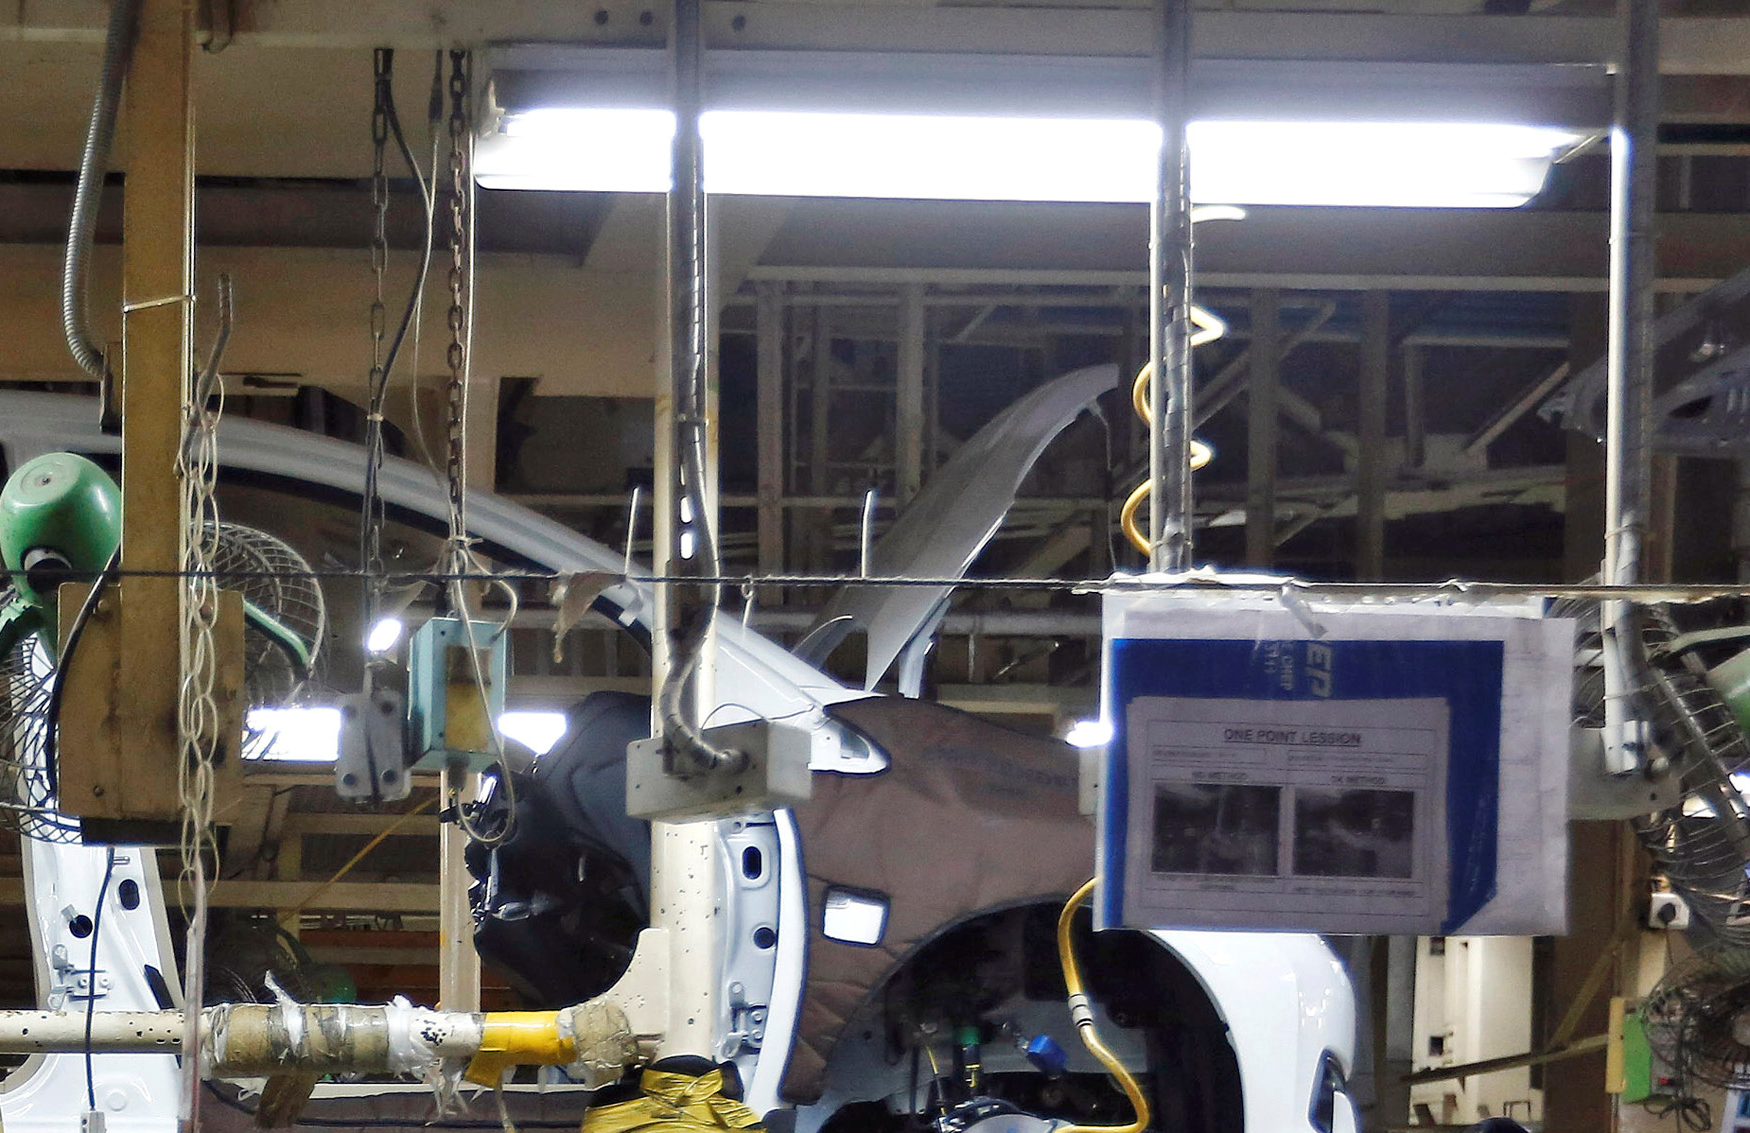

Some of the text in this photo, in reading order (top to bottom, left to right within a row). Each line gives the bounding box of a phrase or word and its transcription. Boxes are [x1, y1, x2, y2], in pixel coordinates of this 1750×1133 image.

[1224, 728, 1361, 745] ONE POINT LESSION
